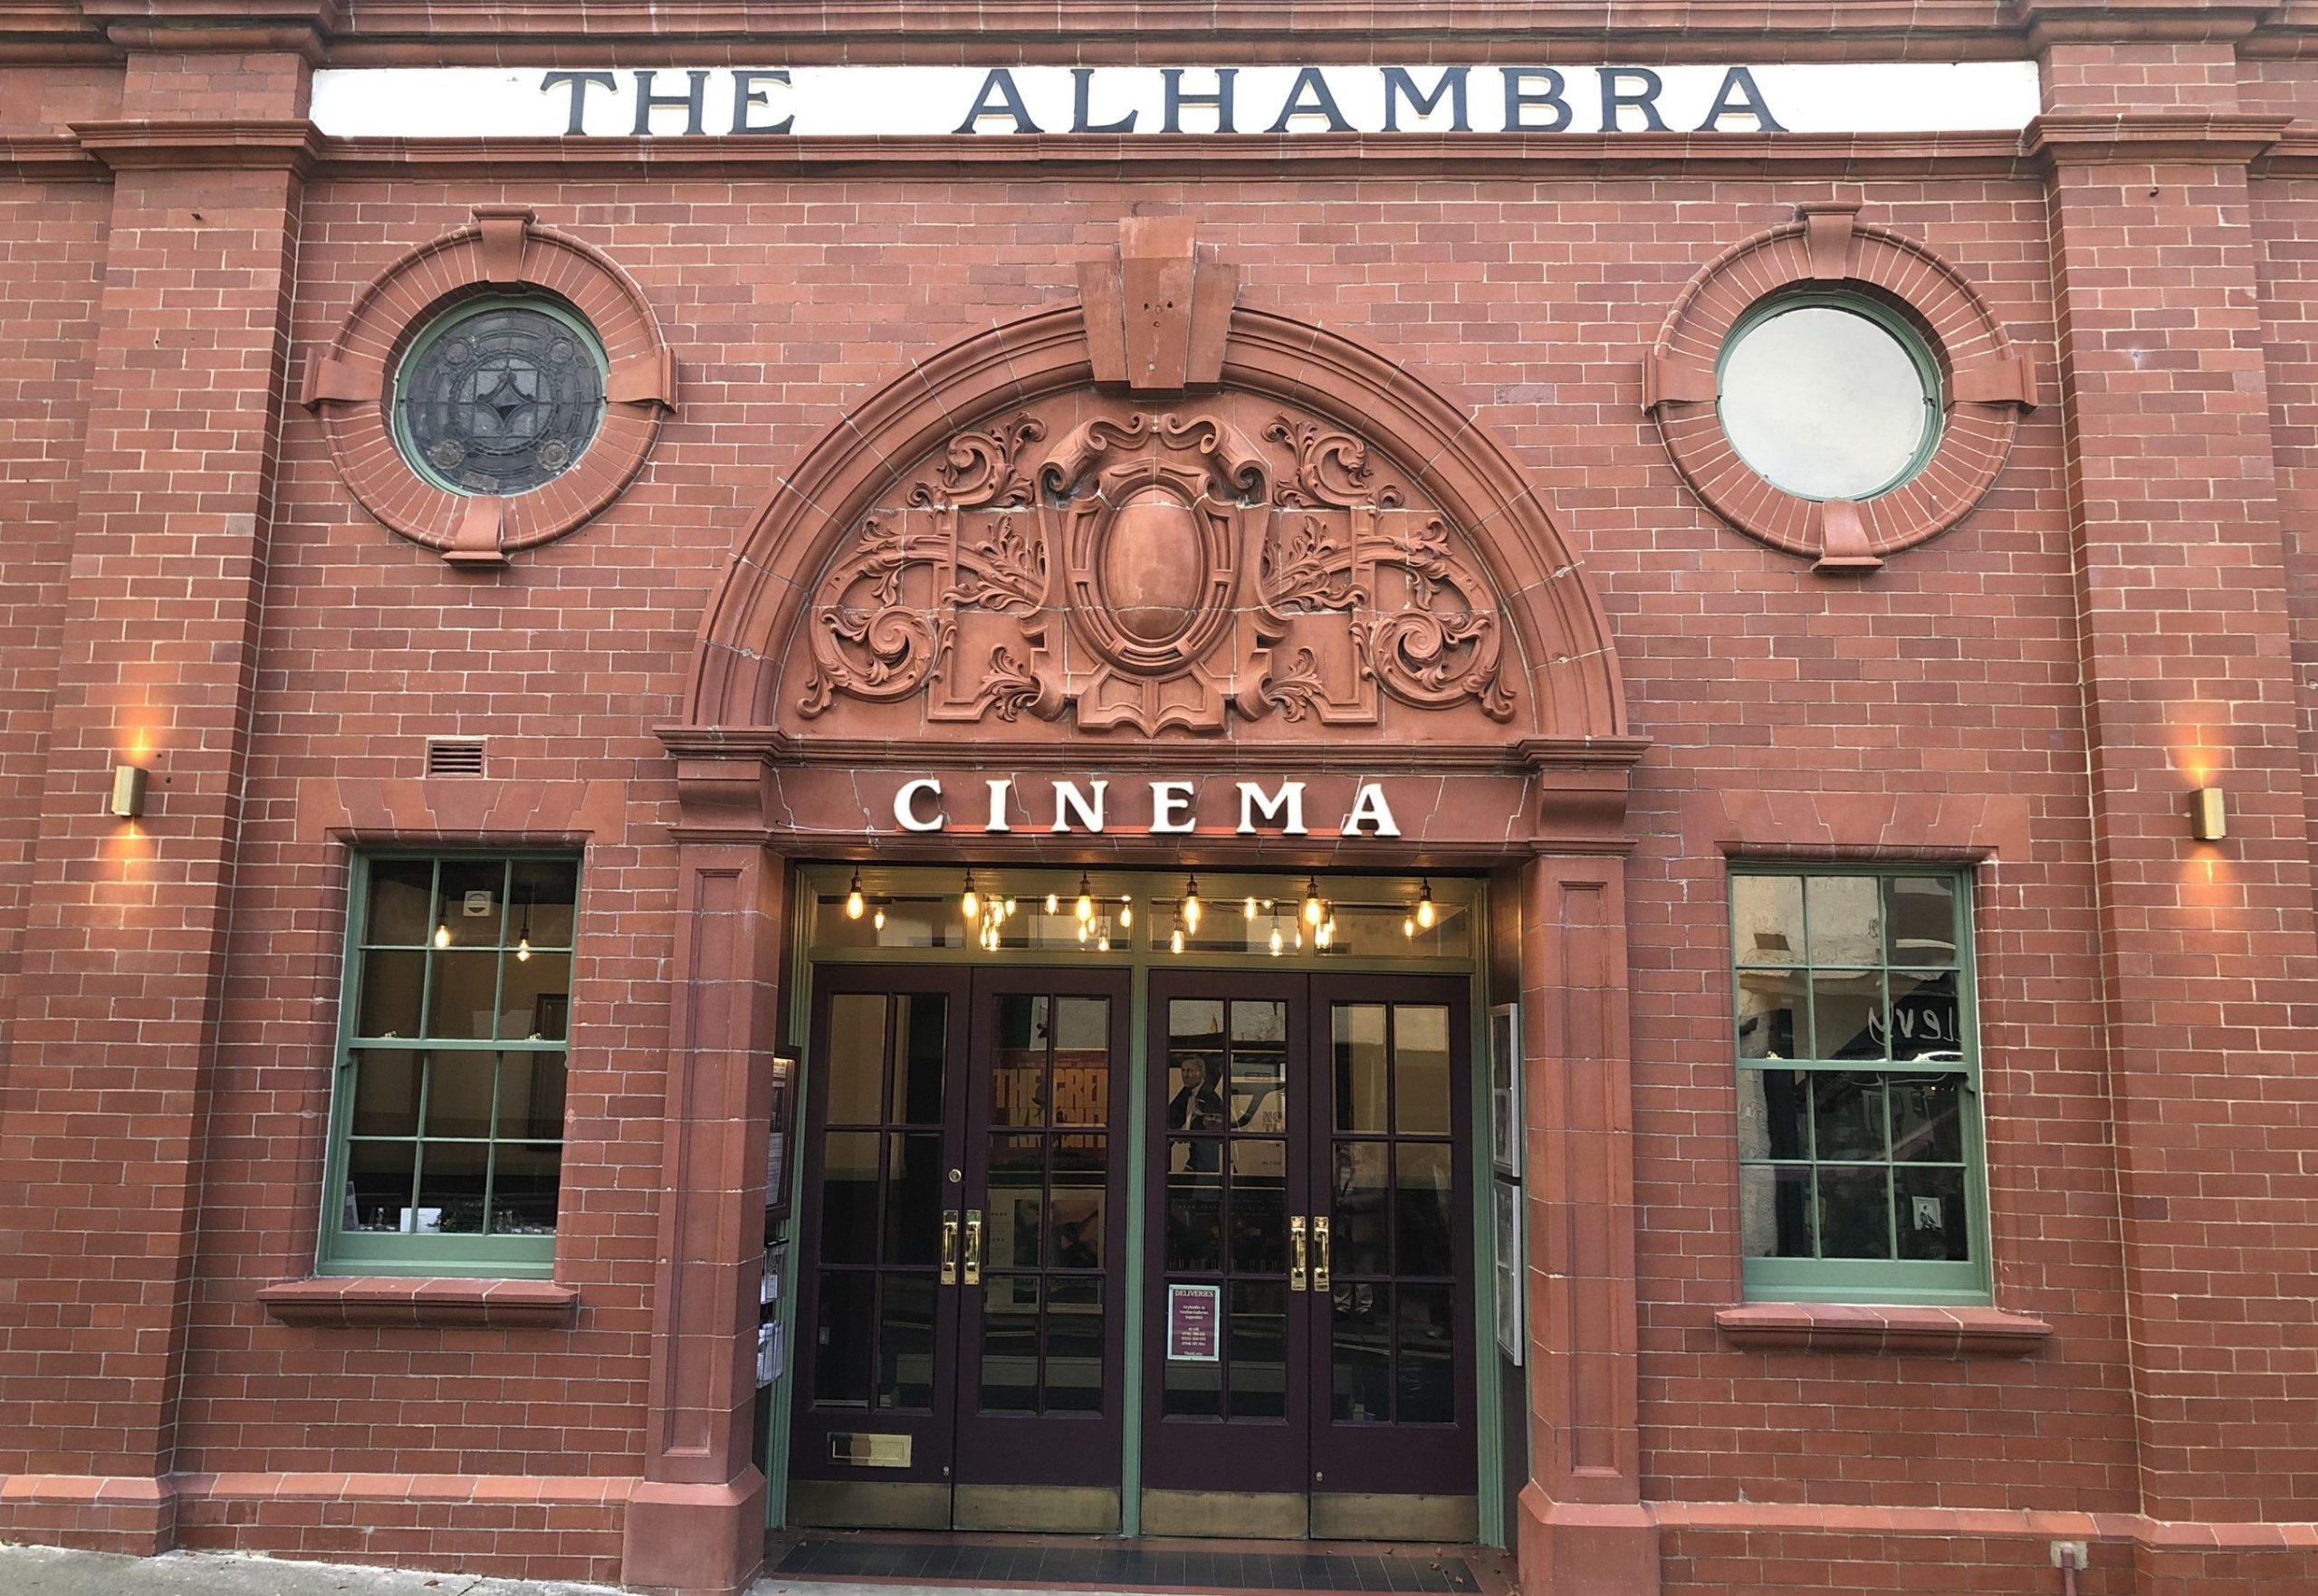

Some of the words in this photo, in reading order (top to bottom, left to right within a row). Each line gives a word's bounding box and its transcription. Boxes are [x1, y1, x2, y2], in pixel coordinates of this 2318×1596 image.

[540, 71, 795, 136] THE
[951, 66, 1790, 134] ALHAMBRA
[892, 779, 1402, 836] CINEMA
[993, 1068, 1042, 1109] THE
